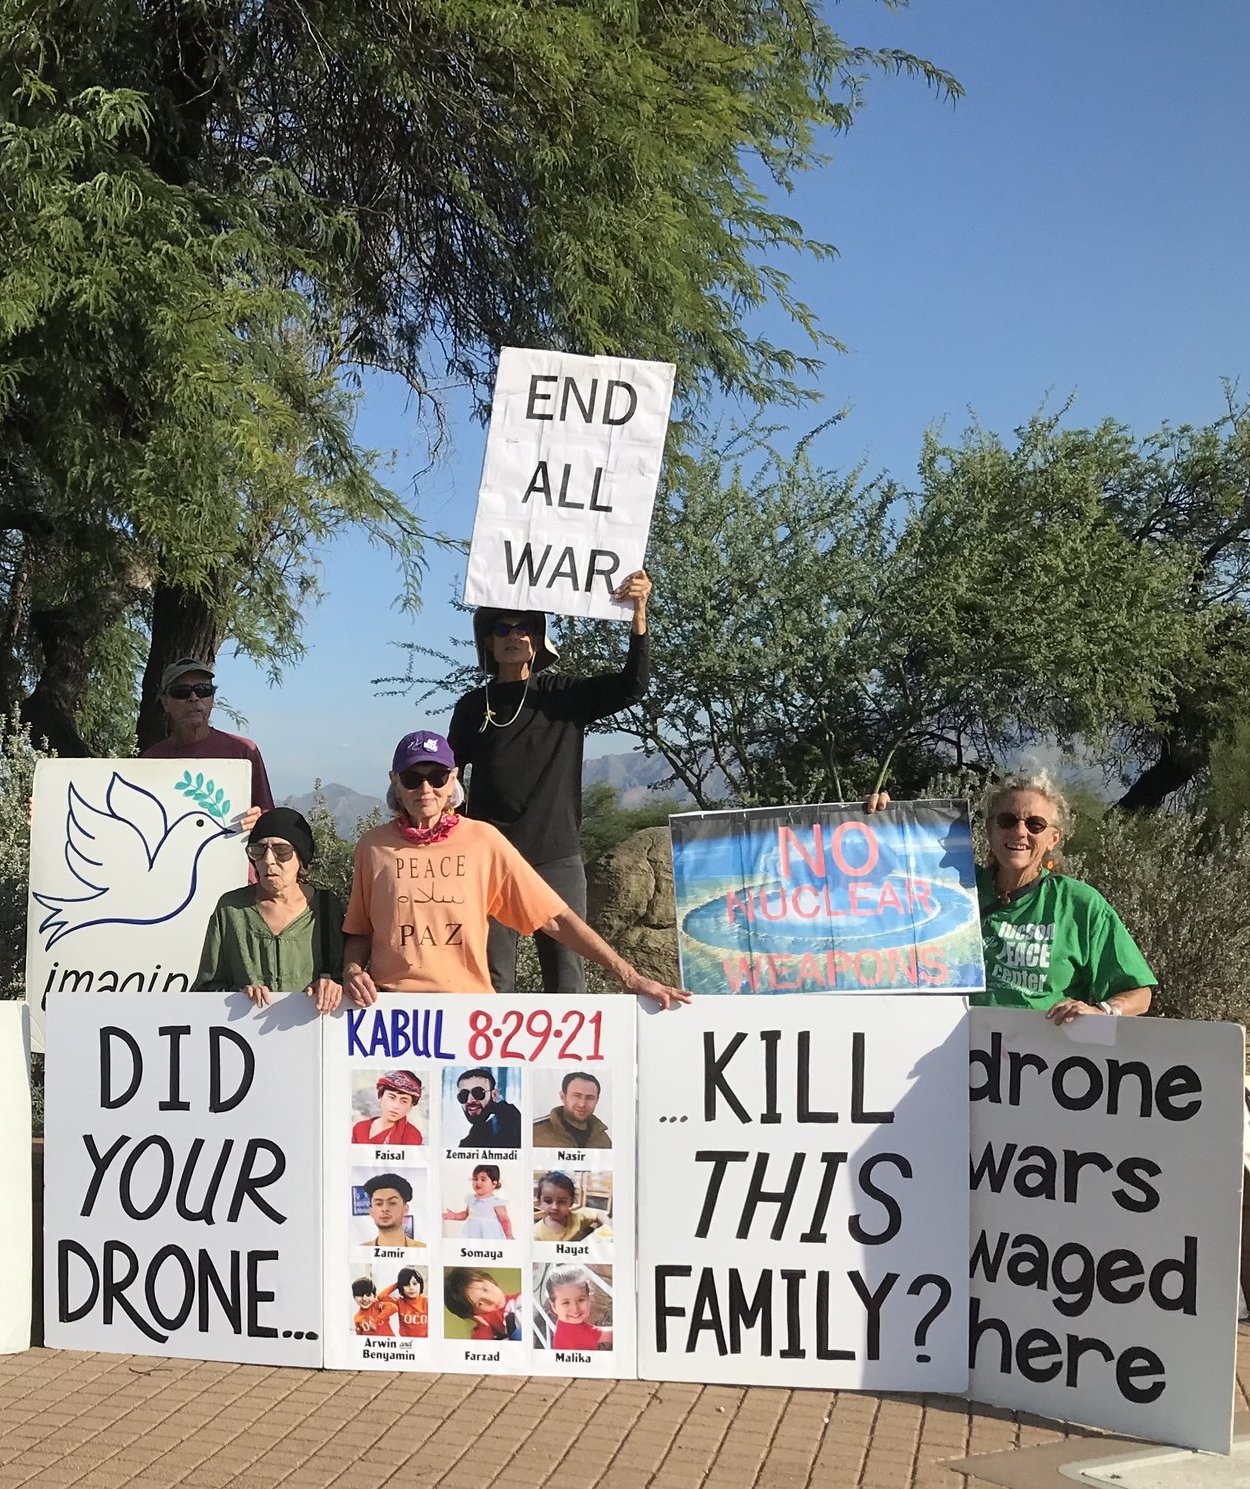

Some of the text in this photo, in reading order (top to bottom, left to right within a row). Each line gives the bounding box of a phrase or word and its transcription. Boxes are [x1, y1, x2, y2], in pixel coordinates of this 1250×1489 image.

[525, 374, 638, 426] END
[521, 461, 613, 513] ALL
[504, 540, 620, 594] WAR
[396, 855, 466, 879] PEACE
[778, 821, 879, 880] NO
[726, 880, 933, 926] NUCLEAR
[400, 923, 464, 946] PAZ
[723, 946, 950, 993] WEAPONS
[347, 1009, 455, 1060] KABUL
[100, 1025, 255, 1113] DID
[969, 1032, 1202, 1121] drone
[375, 1150, 405, 1161] Faisal
[446, 1149, 517, 1161] Zemari Ahmadi
[557, 1150, 586, 1161] Nasir
[969, 1141, 1162, 1213] wars
[80, 1134, 287, 1225] YOUR
[694, 1150, 913, 1245] THIS
[374, 1248, 405, 1258] Zamir
[461, 1248, 503, 1259] Somaya
[556, 1244, 589, 1256] Hayat
[58, 1239, 319, 1343] DRONE...
[655, 1265, 952, 1363] FAMILY?
[363, 1349, 415, 1361] Benyamin
[365, 1338, 396, 1348] Arwin
[465, 1351, 500, 1362] Farzad
[556, 1352, 592, 1363] Malika
[969, 1297, 1166, 1403] here
